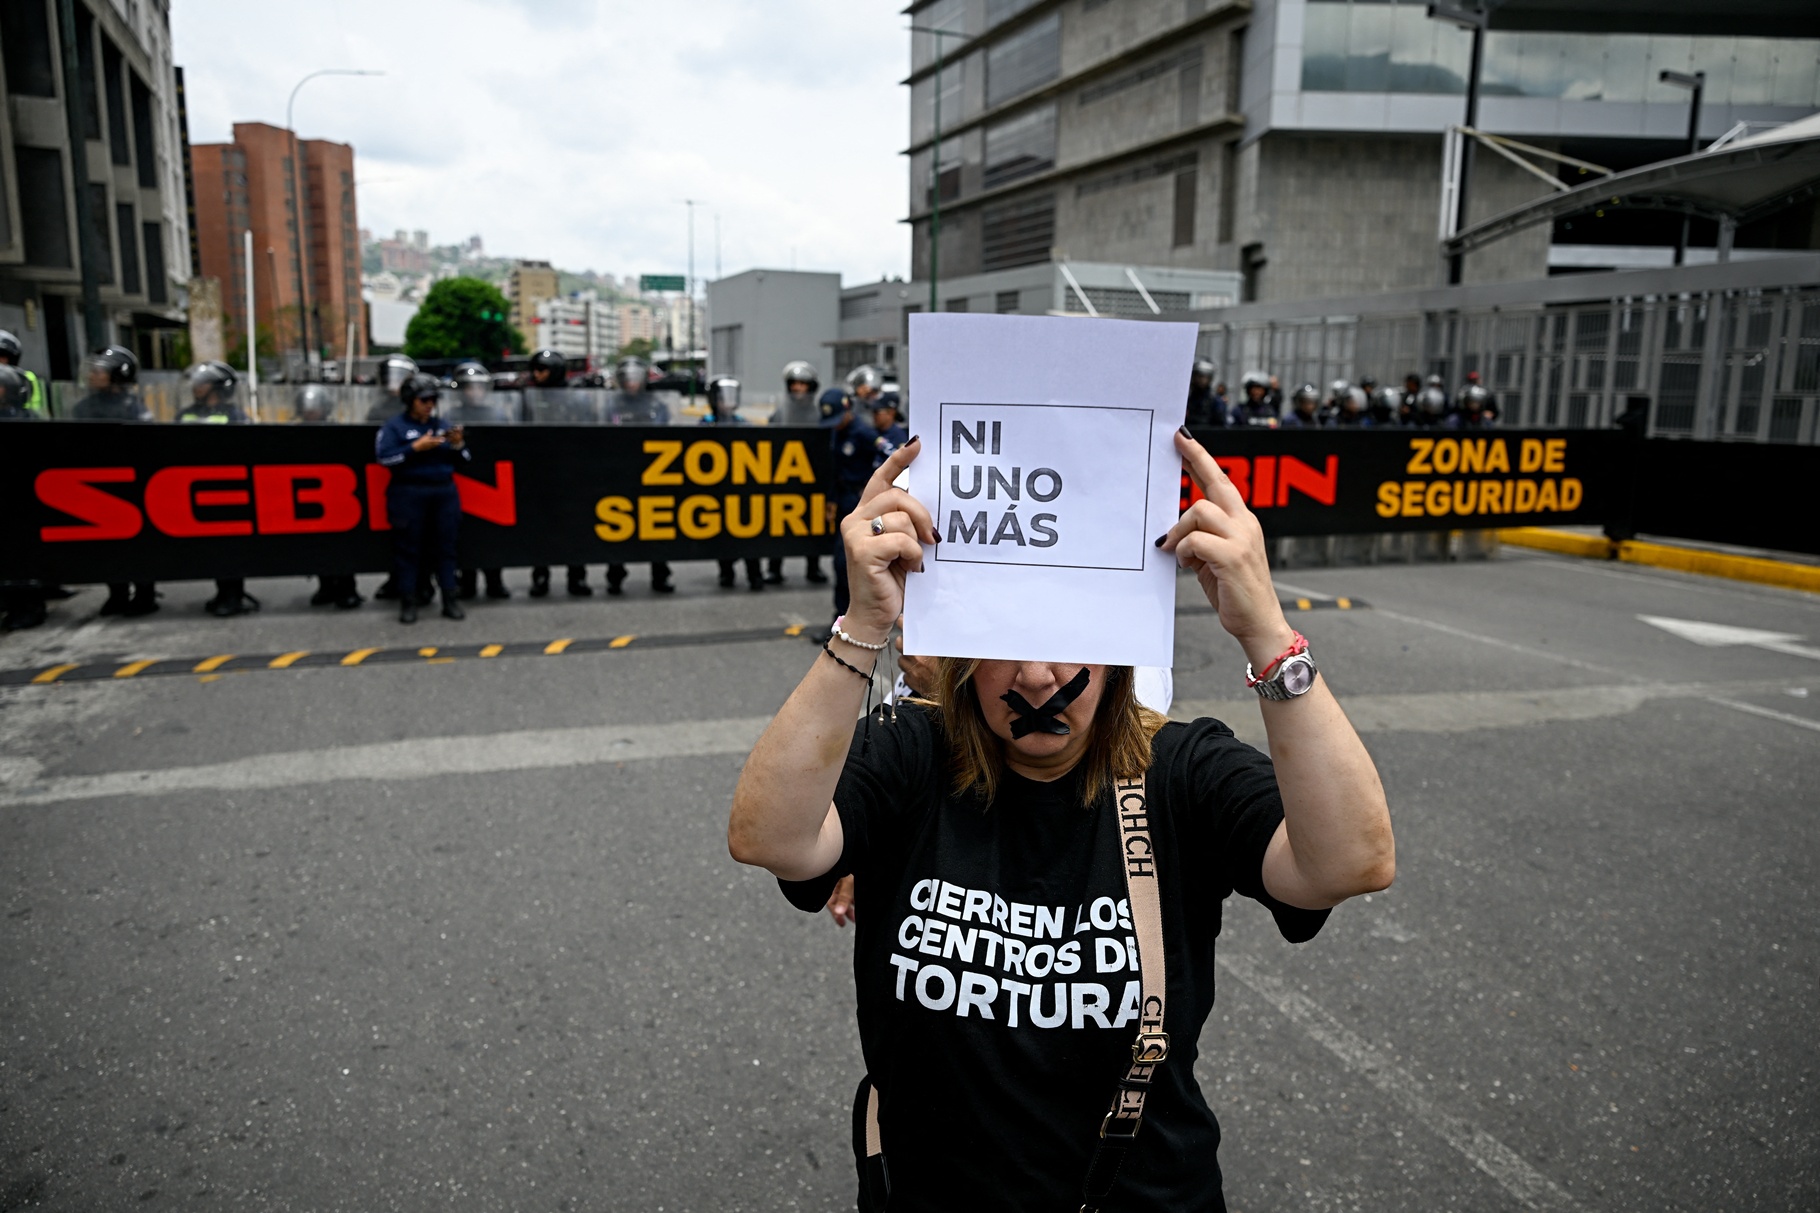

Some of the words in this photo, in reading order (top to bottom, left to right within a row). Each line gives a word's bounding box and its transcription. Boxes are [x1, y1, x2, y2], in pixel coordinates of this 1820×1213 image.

[951, 420, 1002, 455] NI
[1406, 438, 1510, 475] ZONA
[1519, 438, 1567, 473] DE
[641, 440, 816, 485] ZONA
[950, 465, 1063, 503] UNO
[595, 493, 835, 542] SEGURI
[1375, 478, 1583, 518] SEGURIDAD
[946, 504, 1059, 548] MÁS
[910, 879, 1065, 939] CIERREN
[898, 915, 1082, 978] CENTROS
[890, 953, 1141, 1029] TORTURA
